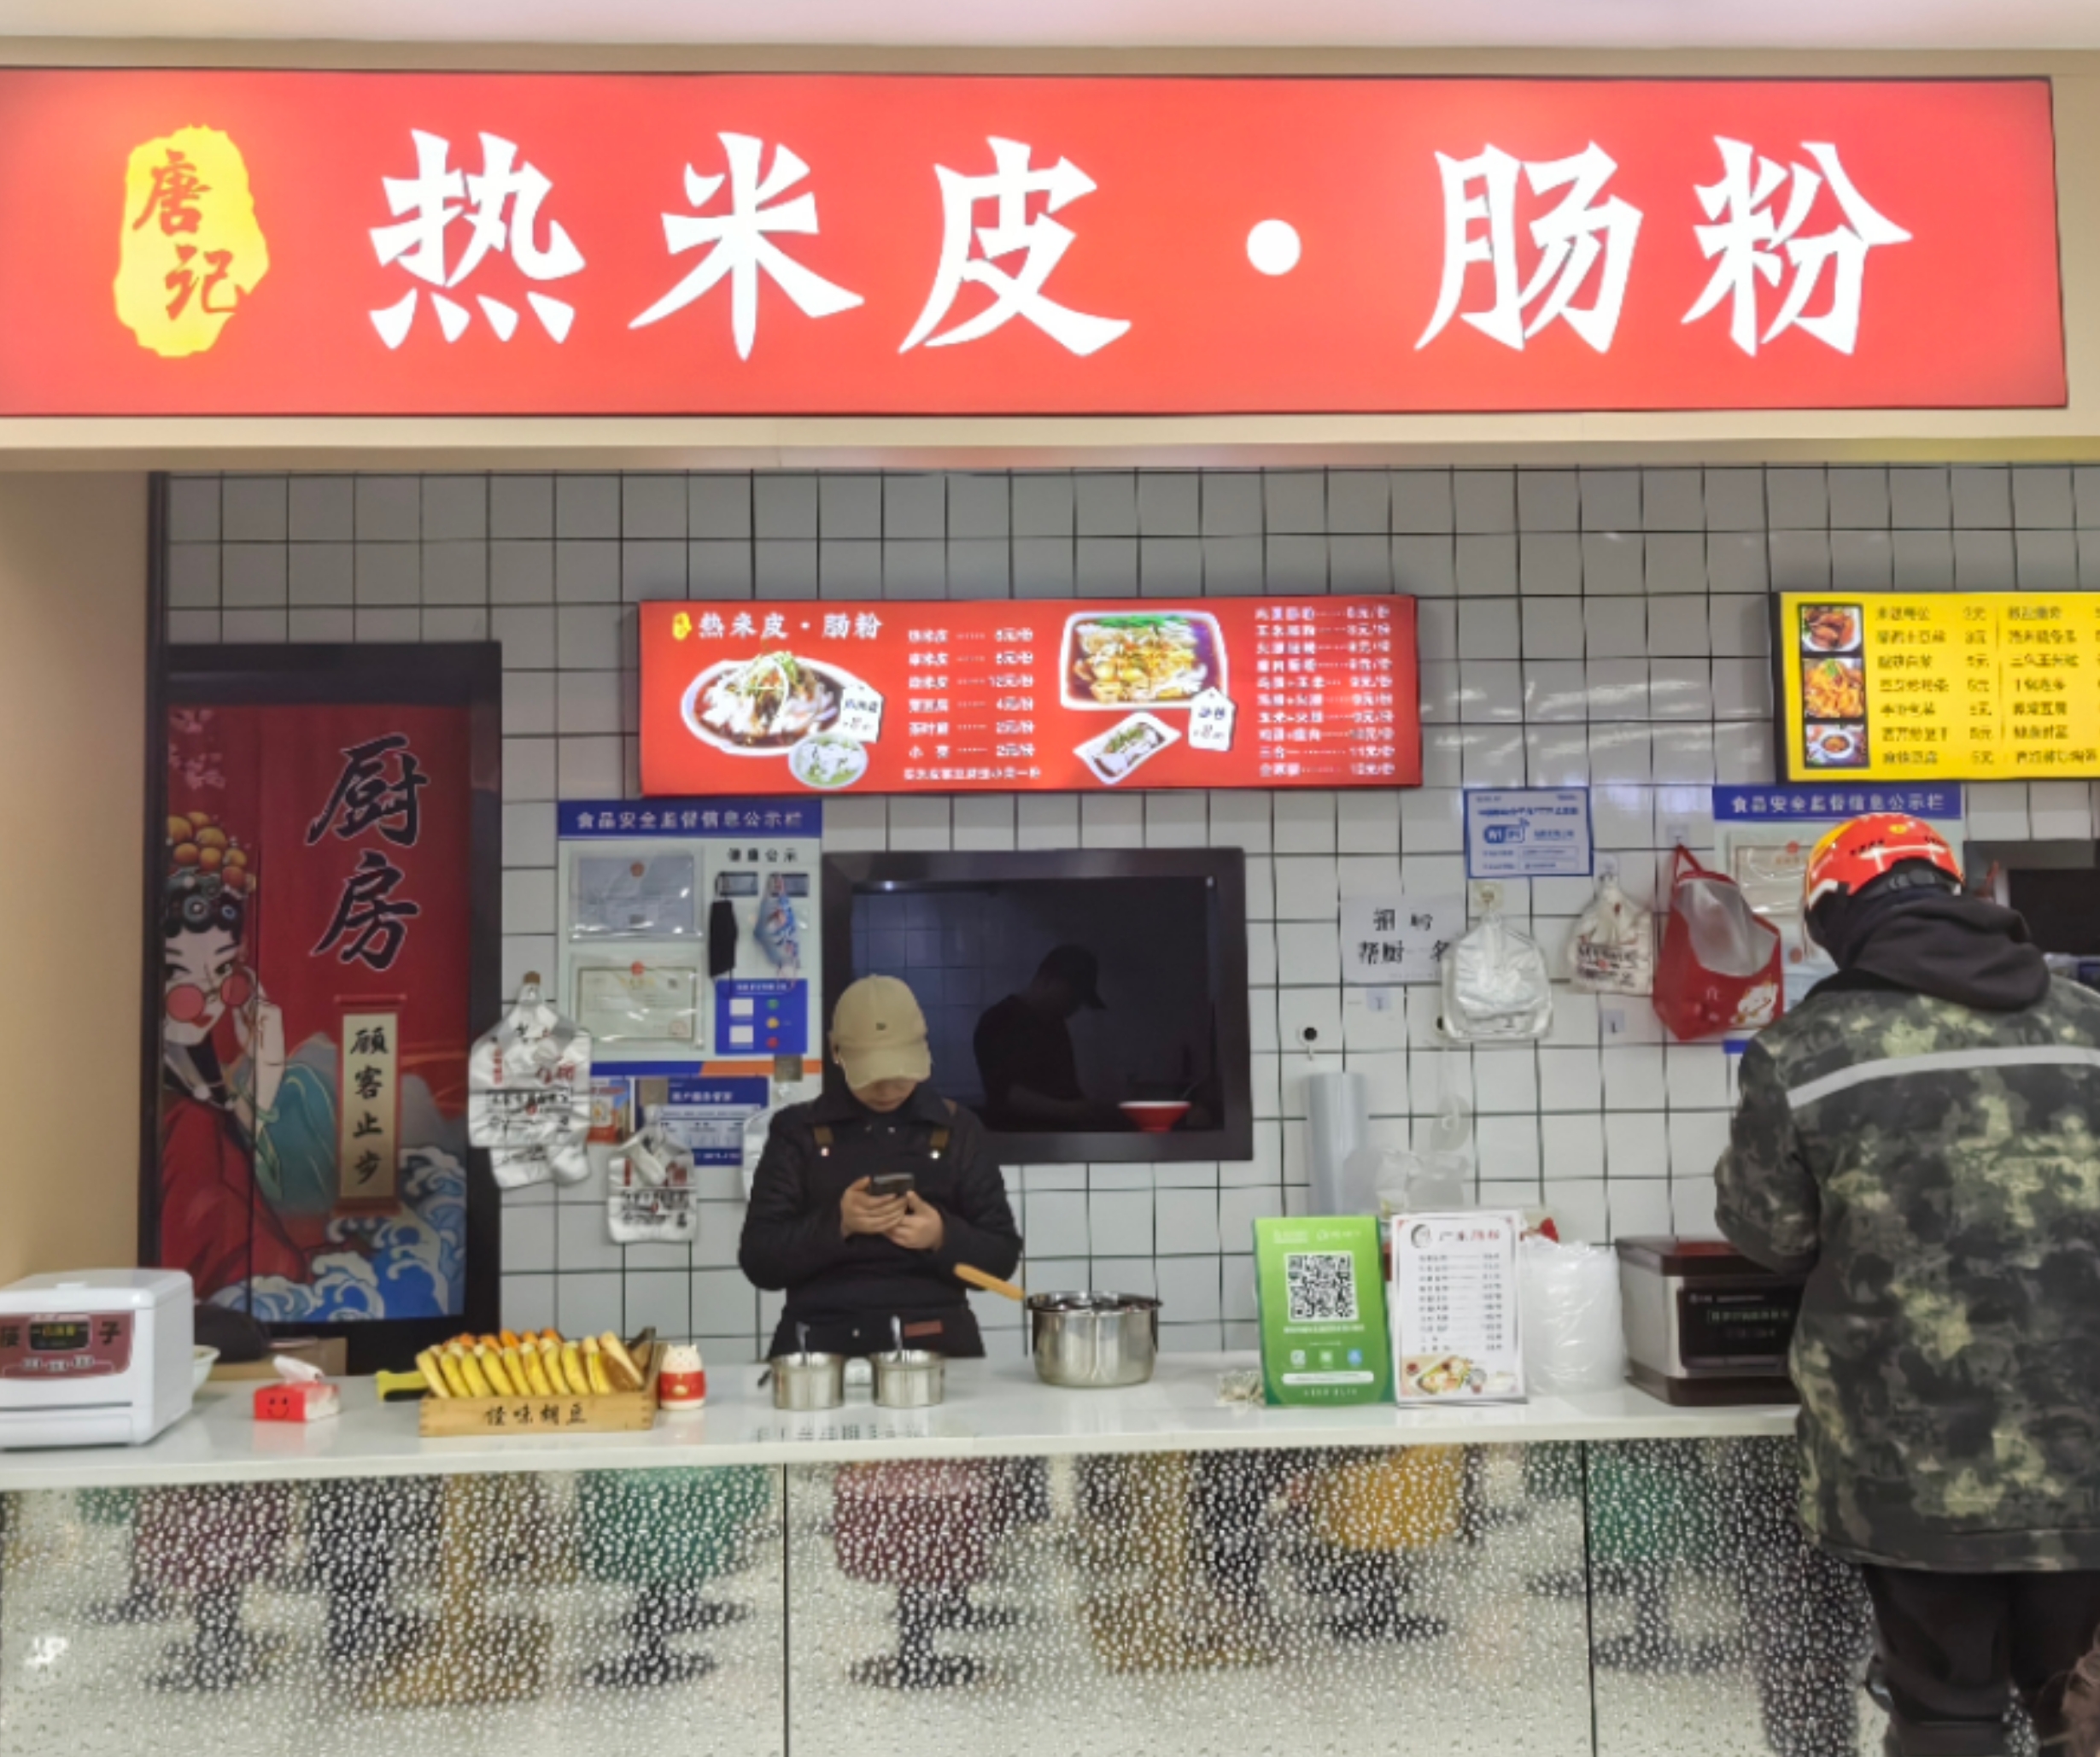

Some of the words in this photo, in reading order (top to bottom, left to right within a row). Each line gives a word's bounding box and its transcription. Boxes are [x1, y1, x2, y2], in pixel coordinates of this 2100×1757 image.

[132, 148, 239, 320] 唐记
[576, 810, 804, 829] 食品安全监督信息公示栏
[1731, 793, 1945, 812] 食品安全监督信息公示栏
[305, 733, 430, 970] 厨房
